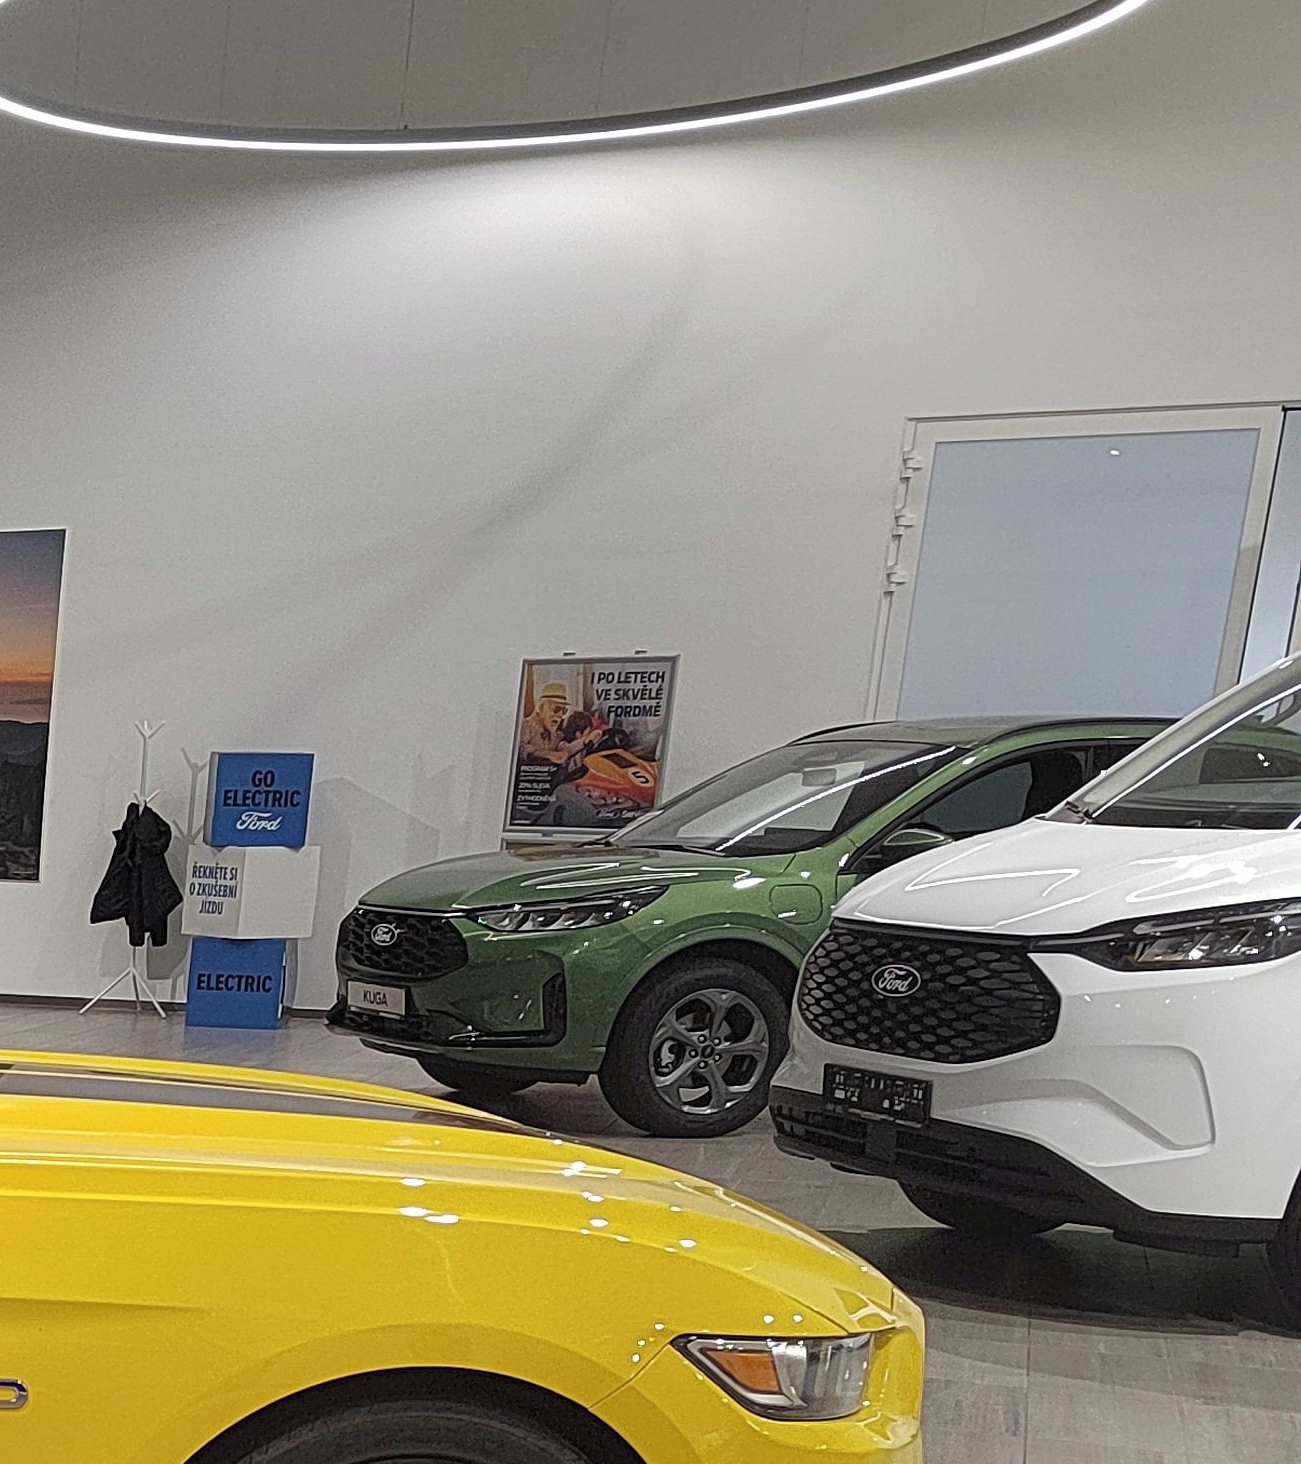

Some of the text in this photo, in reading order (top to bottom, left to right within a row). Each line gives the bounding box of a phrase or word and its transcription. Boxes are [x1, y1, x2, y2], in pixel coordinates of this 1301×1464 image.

[590, 671, 666, 685] I PO LETECH
[595, 685, 664, 701] VE SKVĚLÉ
[607, 702, 662, 718] FORDMÉ
[251, 770, 276, 788] GO
[222, 789, 301, 808] ELECTRIC
[236, 811, 283, 831] Ford
[191, 861, 238, 881] ŘEKNĚTE SI
[189, 881, 239, 898] O ZKUŠEBNÍ
[199, 897, 224, 915] JÍZDU
[196, 973, 273, 993] ELECTRIC
[878, 968, 913, 992] Ford
[363, 989, 389, 1007] KUGA
